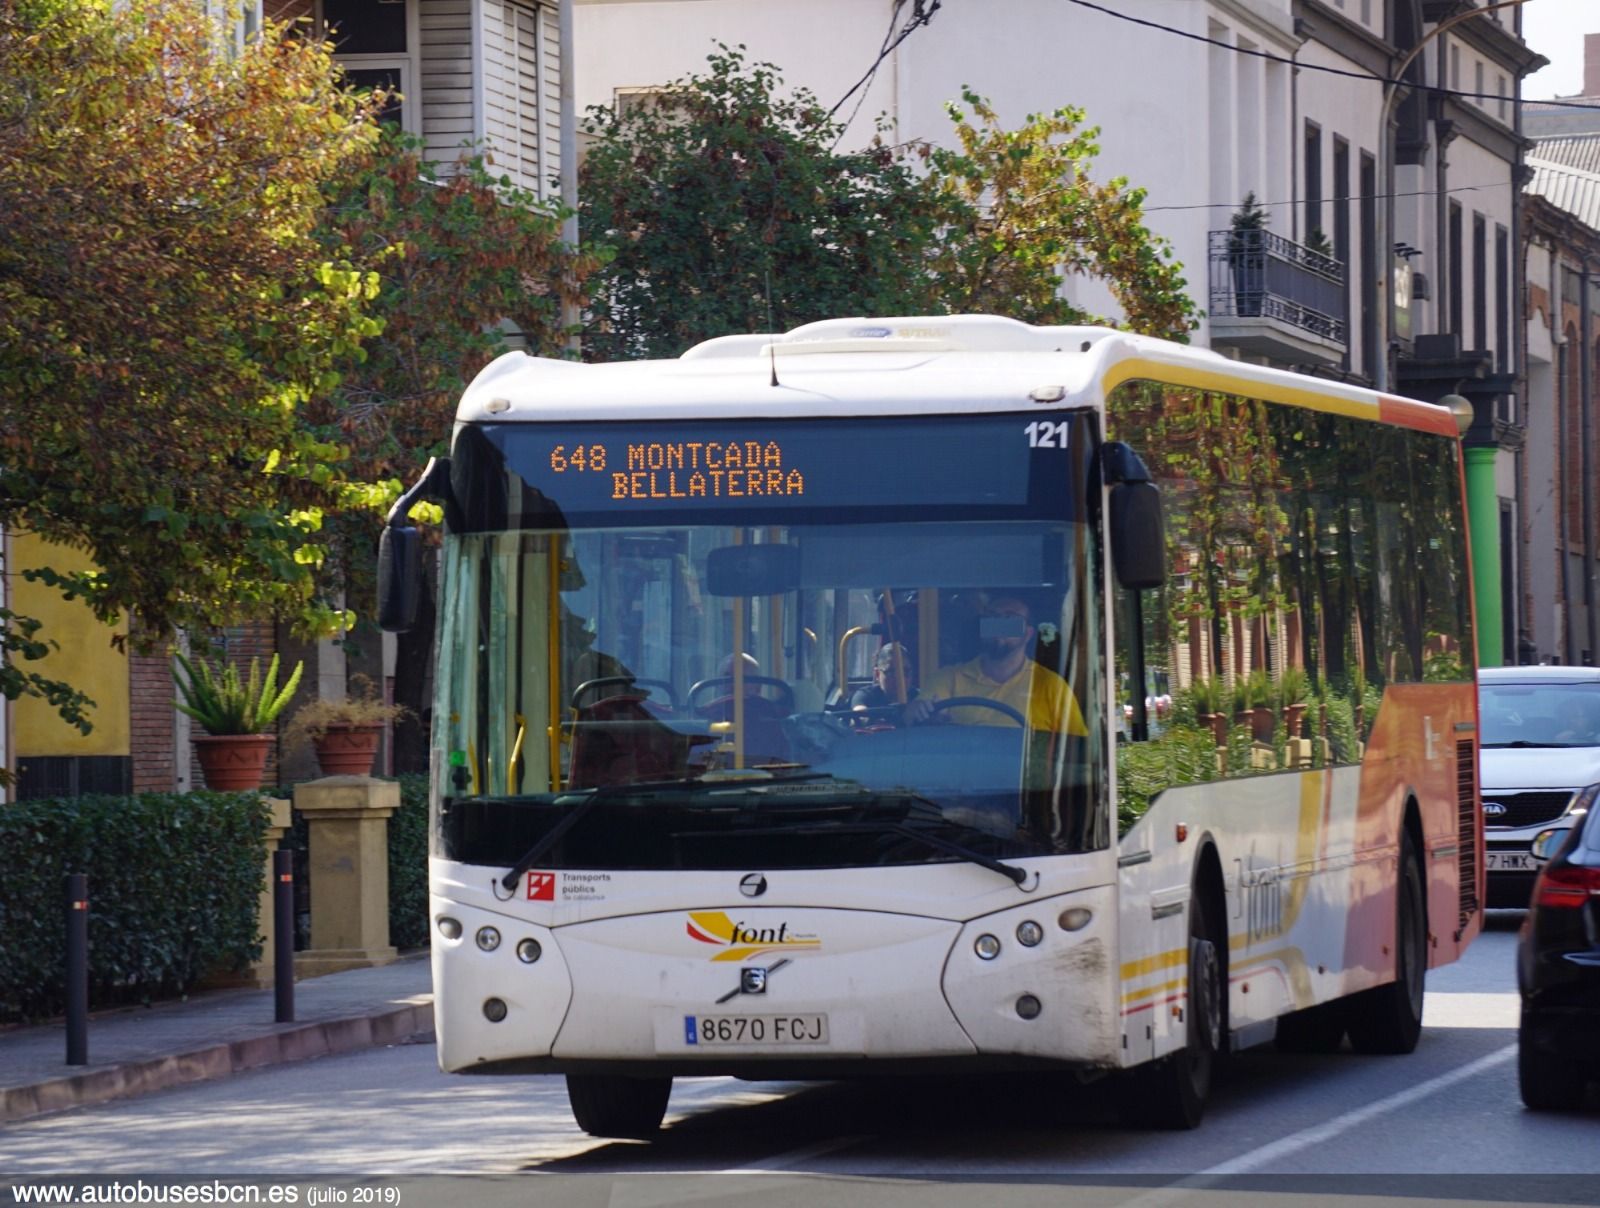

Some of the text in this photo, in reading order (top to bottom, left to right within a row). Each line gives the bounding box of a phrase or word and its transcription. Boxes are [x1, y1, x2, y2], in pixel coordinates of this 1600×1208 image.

[1024, 421, 1068, 448] 121
[551, 441, 781, 472] 648 MONTCADA
[612, 469, 804, 498] BELLATERRA
[562, 884, 595, 894] públics
[563, 873, 611, 882] Transports
[731, 921, 787, 945] font
[702, 1018, 764, 1041] 8670
[774, 1017, 821, 1041] FCJ
